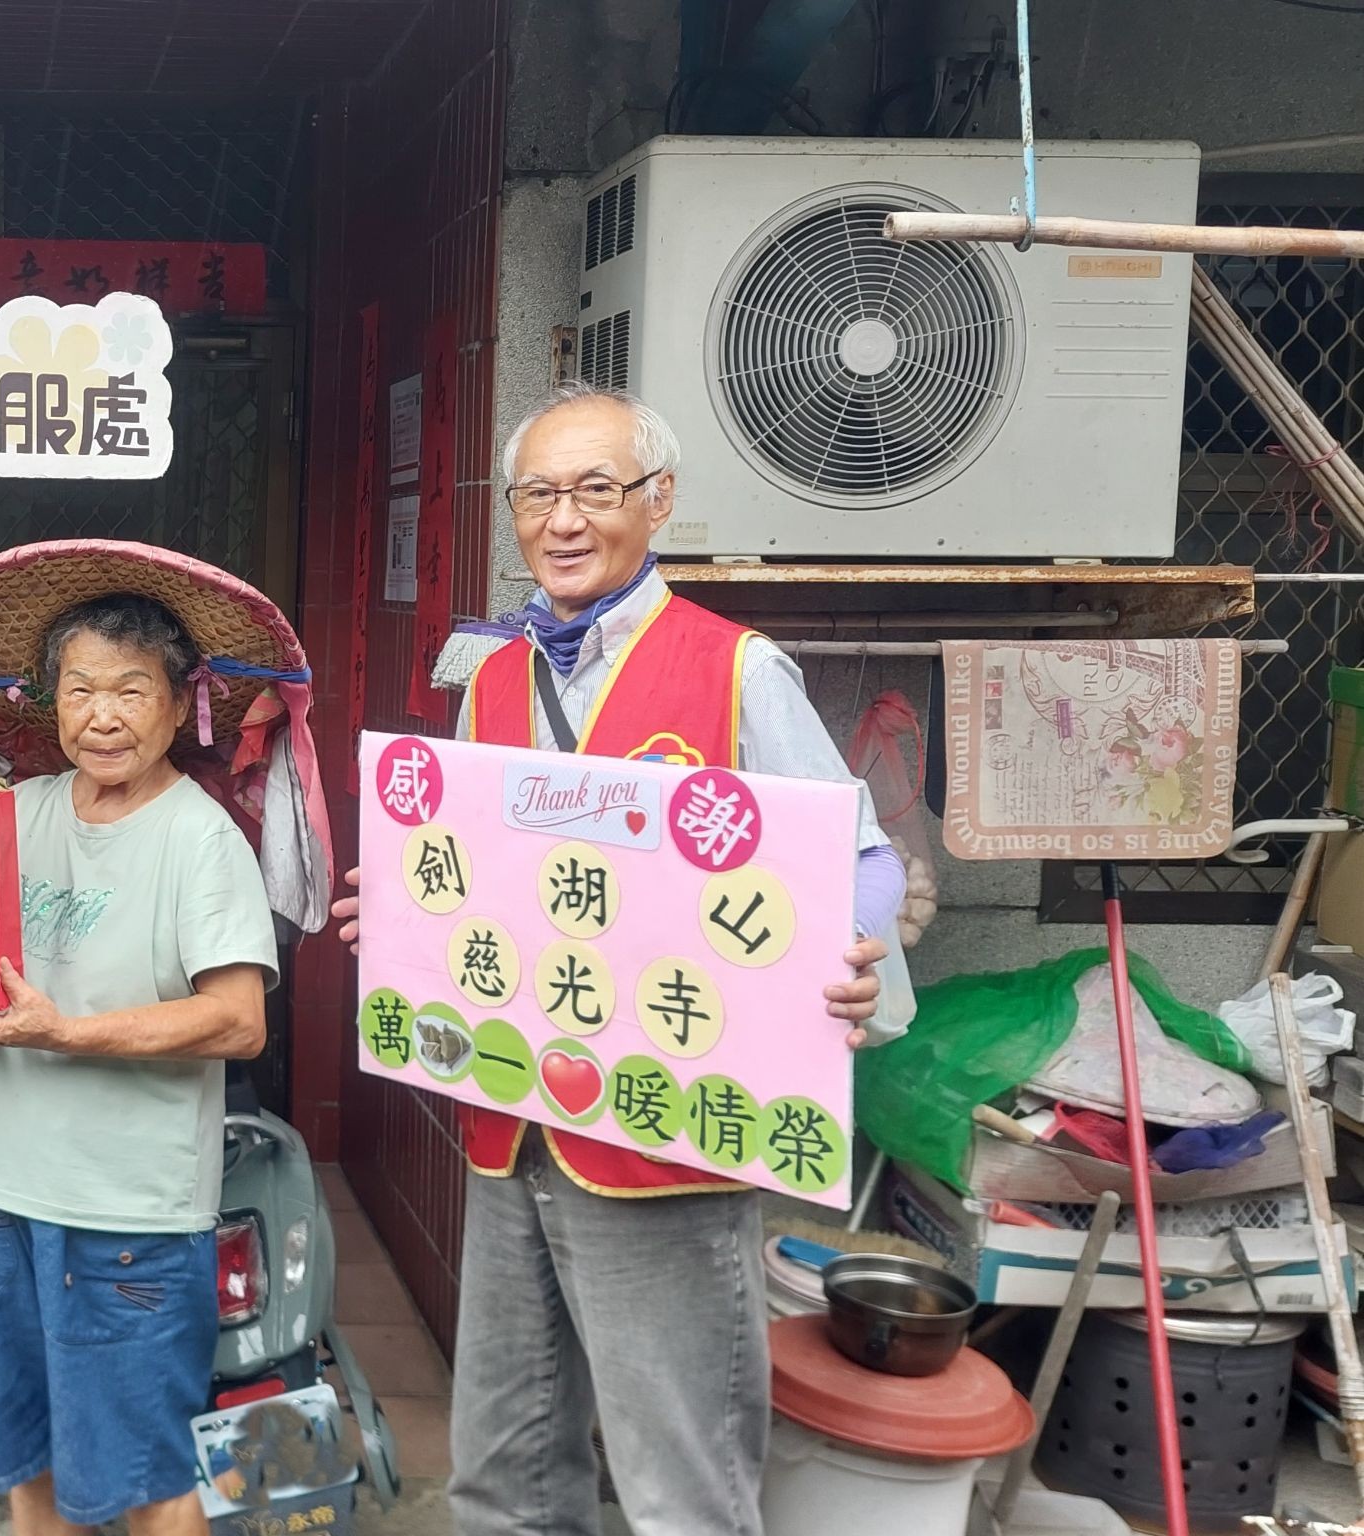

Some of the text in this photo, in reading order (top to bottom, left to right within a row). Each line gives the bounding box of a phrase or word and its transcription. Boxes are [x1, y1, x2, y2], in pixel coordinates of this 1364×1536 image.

[1094, 261, 1152, 272] HITCHI
[950, 653, 972, 705] like
[951, 713, 971, 798] Would
[513, 771, 639, 823] Thank you
[1082, 834, 1114, 850] so
[1124, 834, 1149, 854] is
